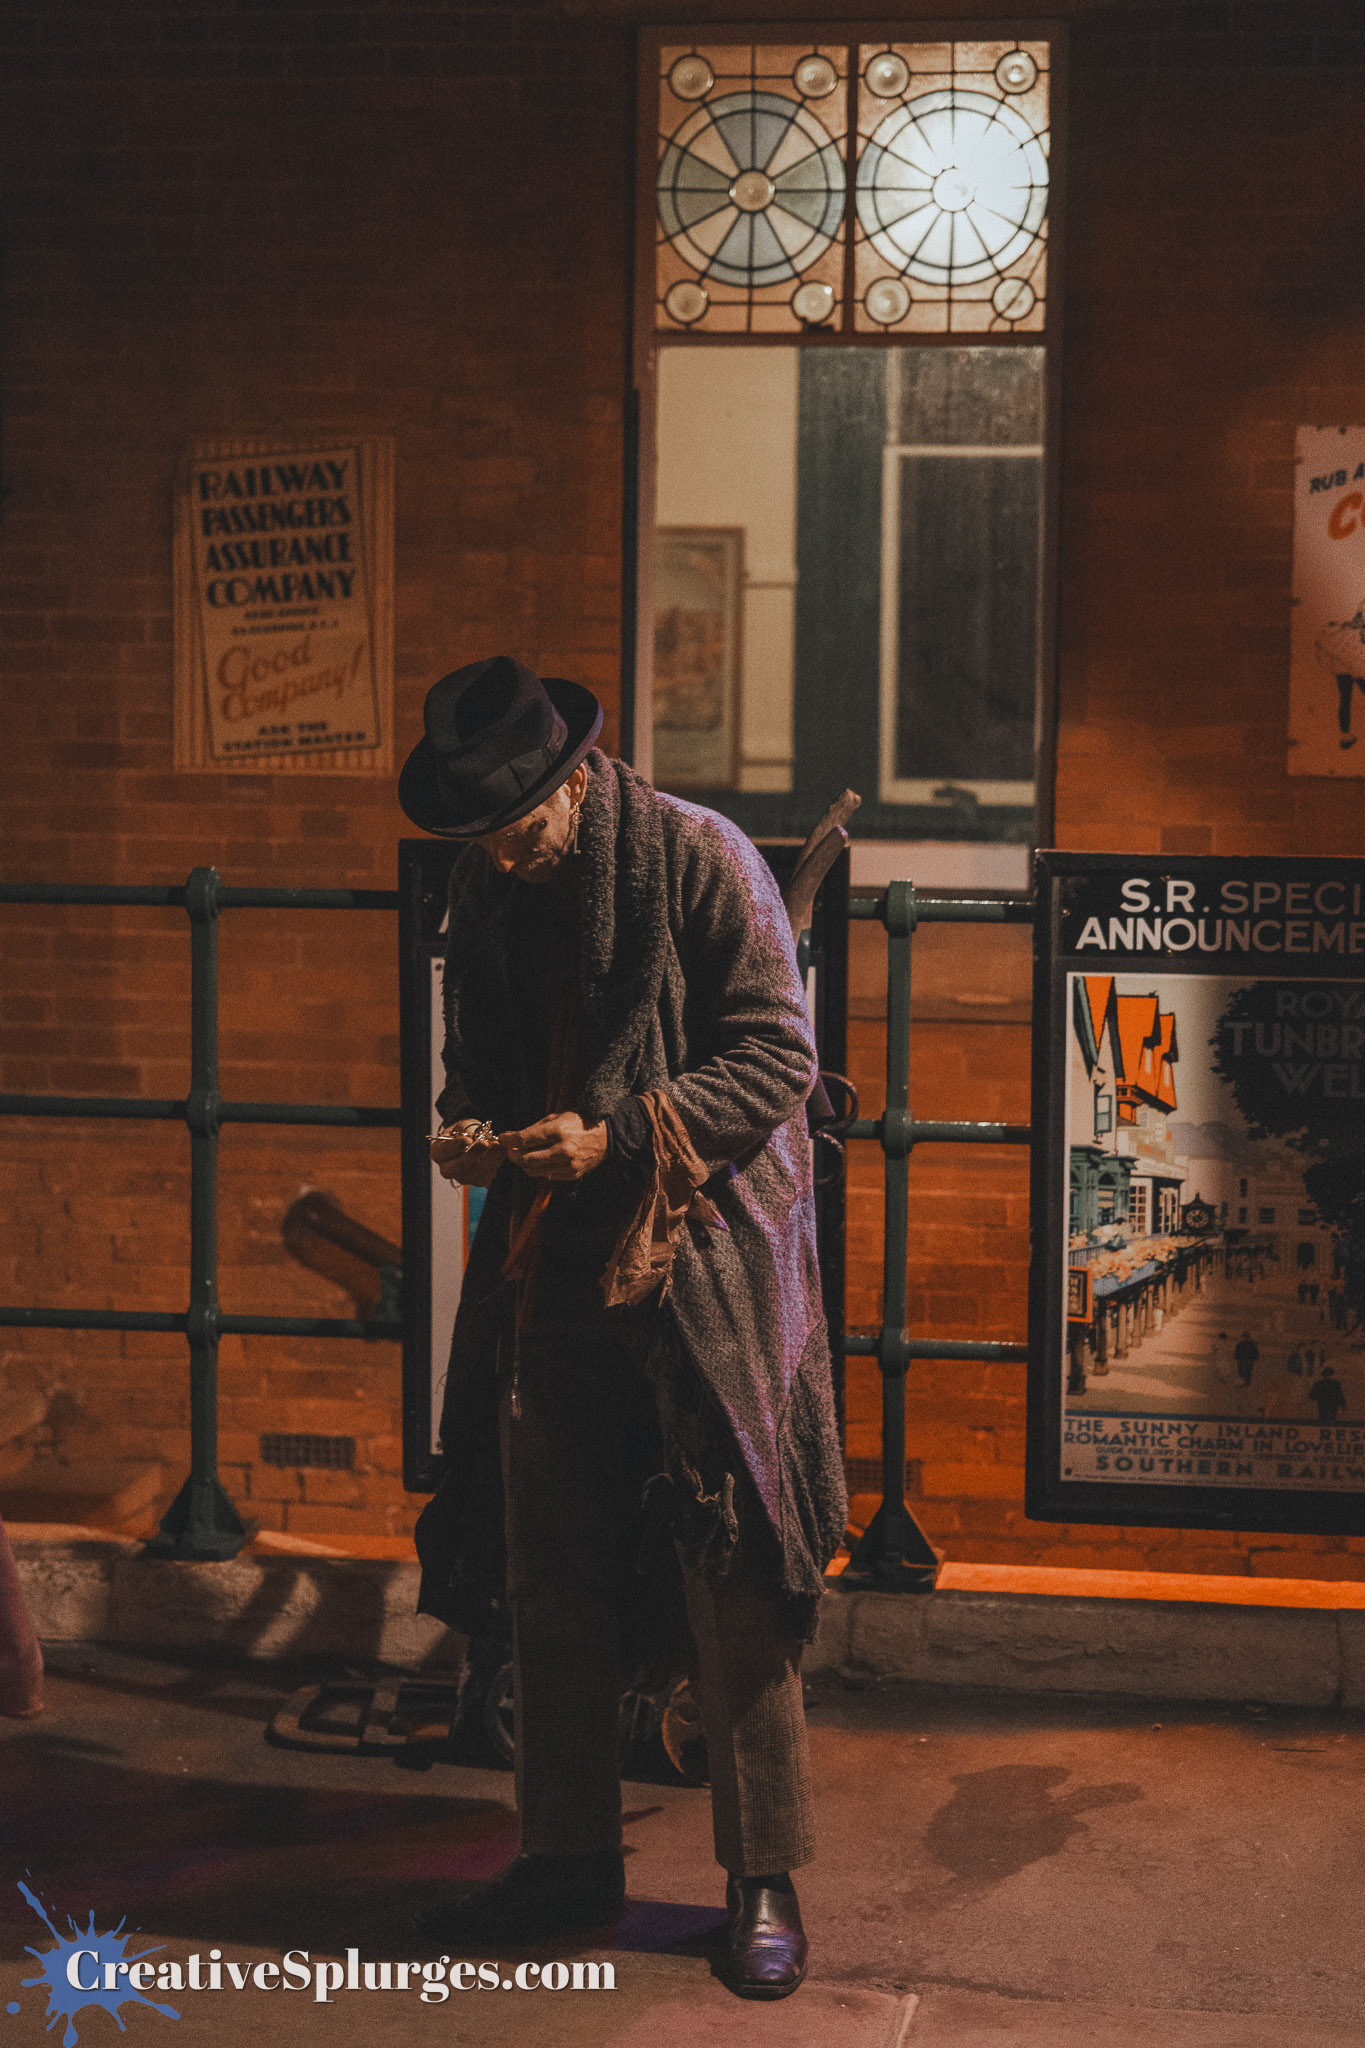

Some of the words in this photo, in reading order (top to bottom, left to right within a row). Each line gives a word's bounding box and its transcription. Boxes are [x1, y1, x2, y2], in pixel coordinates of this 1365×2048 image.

[200, 461, 348, 500] RAILWAY
[1309, 469, 1347, 494] RUB
[202, 497, 350, 537] PASSENGERS
[1328, 492, 1365, 540] C
[205, 533, 351, 571] ASSURANCE
[207, 569, 354, 608] COMPANY
[217, 634, 312, 690] Good
[1219, 880, 1365, 916] SPECI
[1223, 1021, 1365, 1059] TUNBR
[1064, 1432, 1170, 1448] ROMANTIC
[1177, 1436, 1244, 1450] CHARM
[1253, 1440, 1273, 1452] IN
[1065, 1419, 1103, 1432] THE
[1121, 1421, 1199, 1435] SUNNY
[1218, 1425, 1299, 1440] INLAND
[1320, 1428, 1365, 1442] RES
[1096, 1456, 1253, 1476] SOUTHERN
